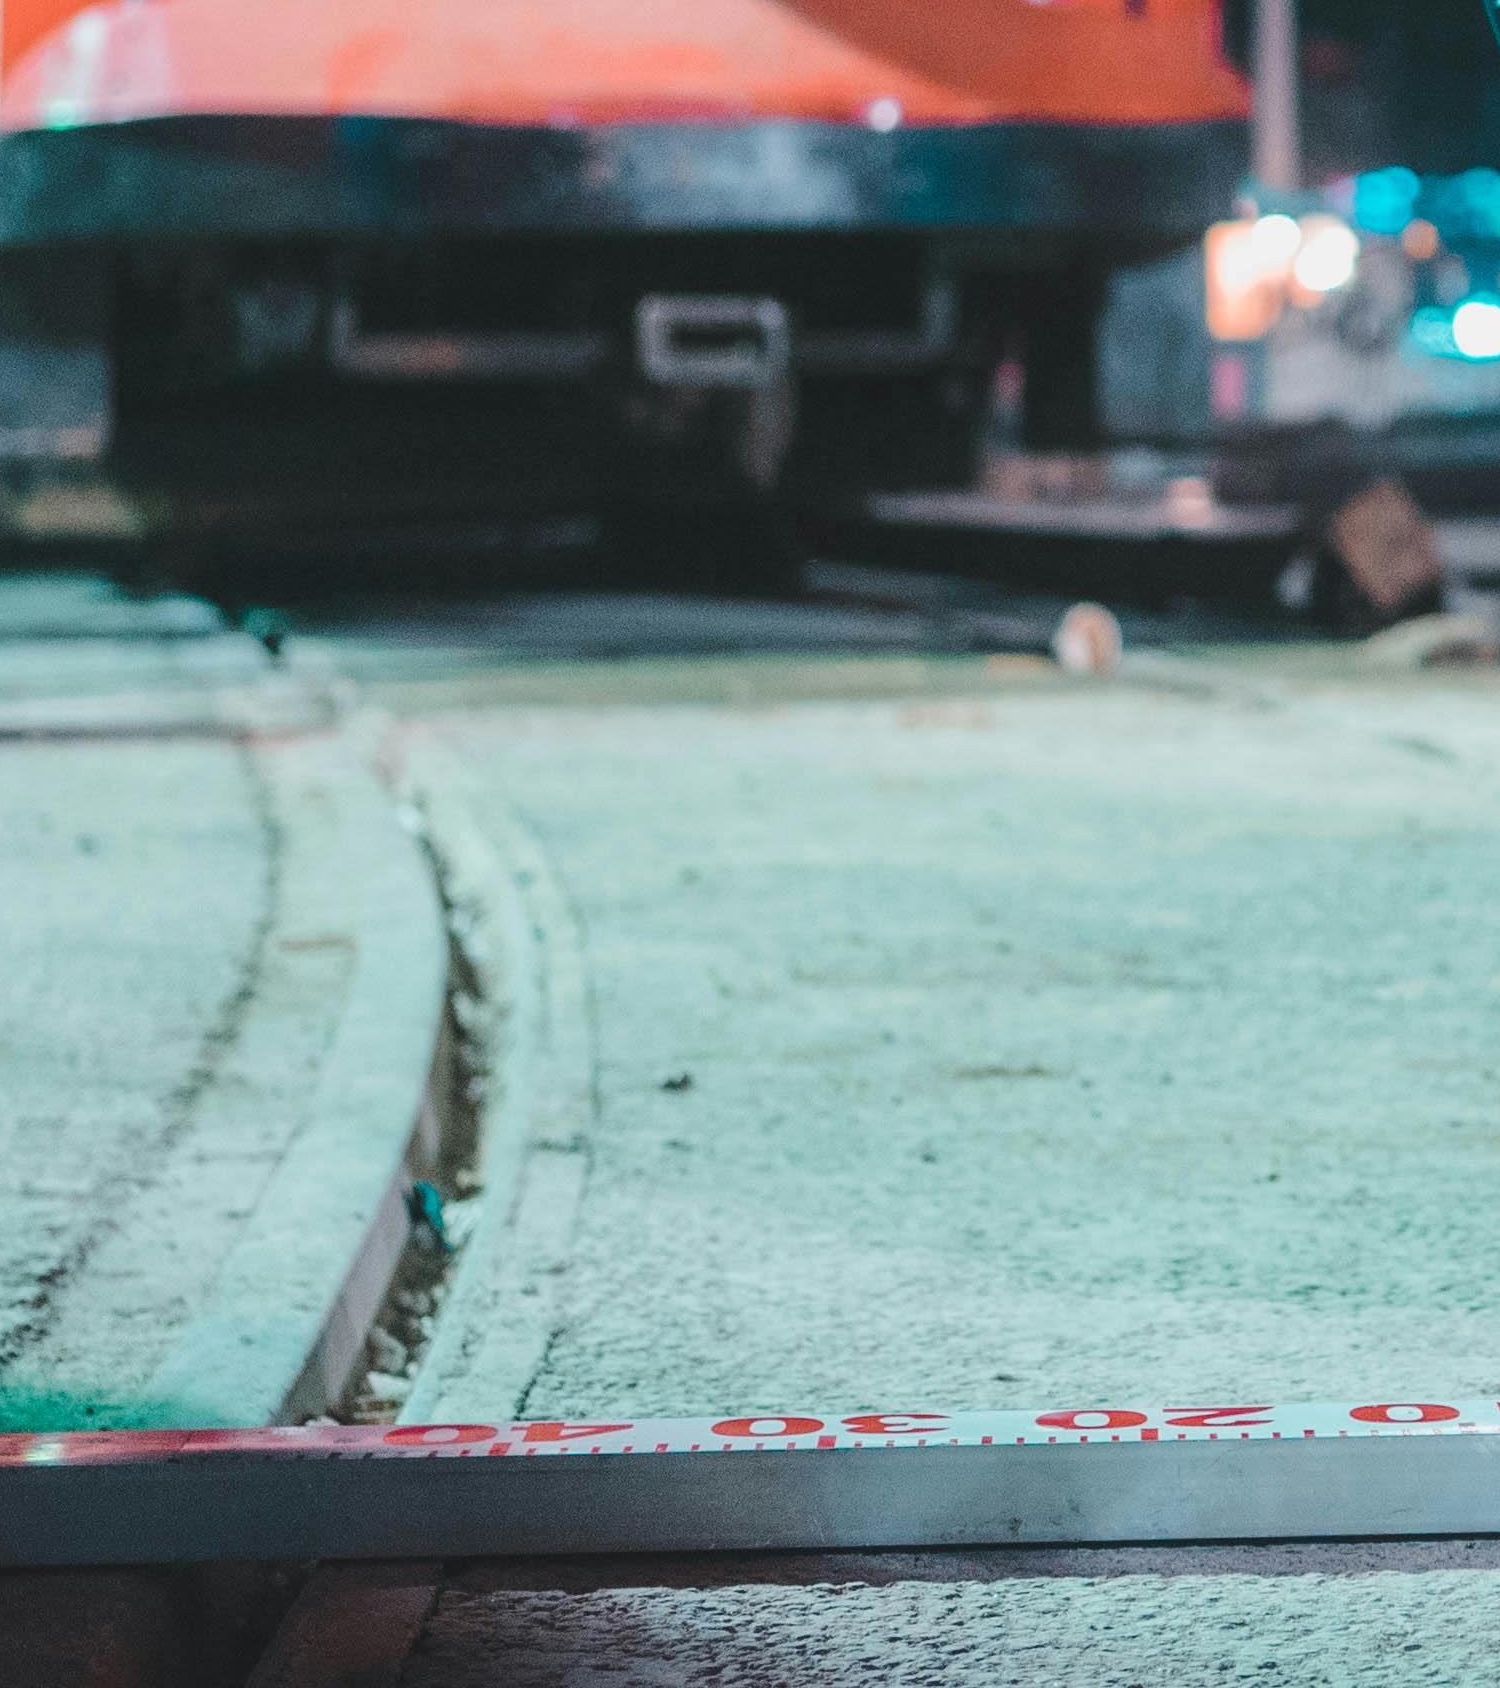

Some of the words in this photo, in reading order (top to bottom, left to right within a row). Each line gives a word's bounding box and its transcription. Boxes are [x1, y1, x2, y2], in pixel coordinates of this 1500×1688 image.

[709, 1413, 953, 1437] 30
[1034, 1405, 1277, 1429] 20
[381, 1422, 636, 1446] 40
